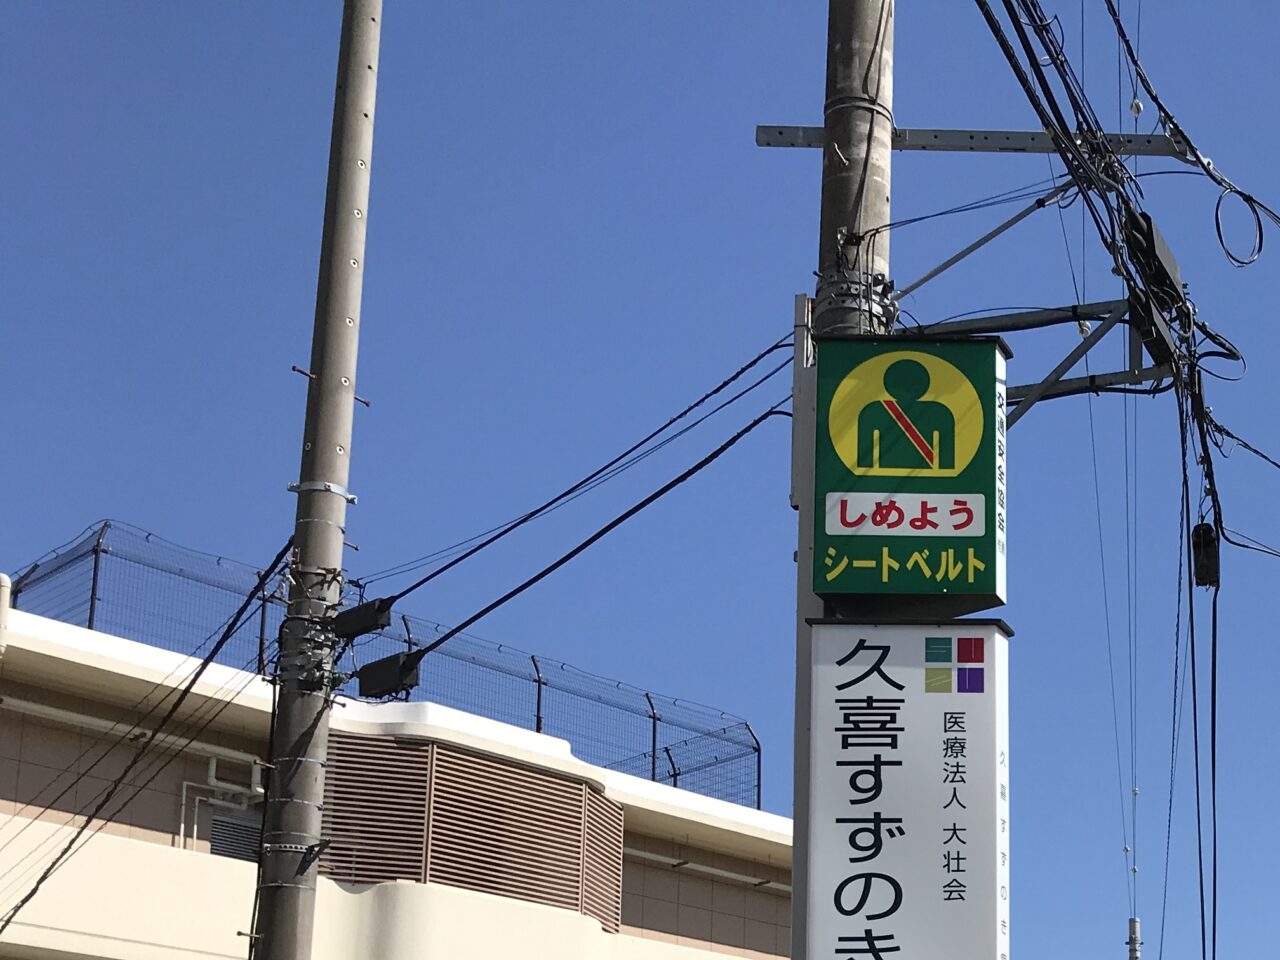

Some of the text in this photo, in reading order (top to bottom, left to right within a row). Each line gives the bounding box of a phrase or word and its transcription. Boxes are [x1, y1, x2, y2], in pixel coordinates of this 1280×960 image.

[840, 499, 974, 531] しめよう
[824, 546, 986, 584] シートベルト
[942, 711, 967, 902] 医療法人 大壮会
